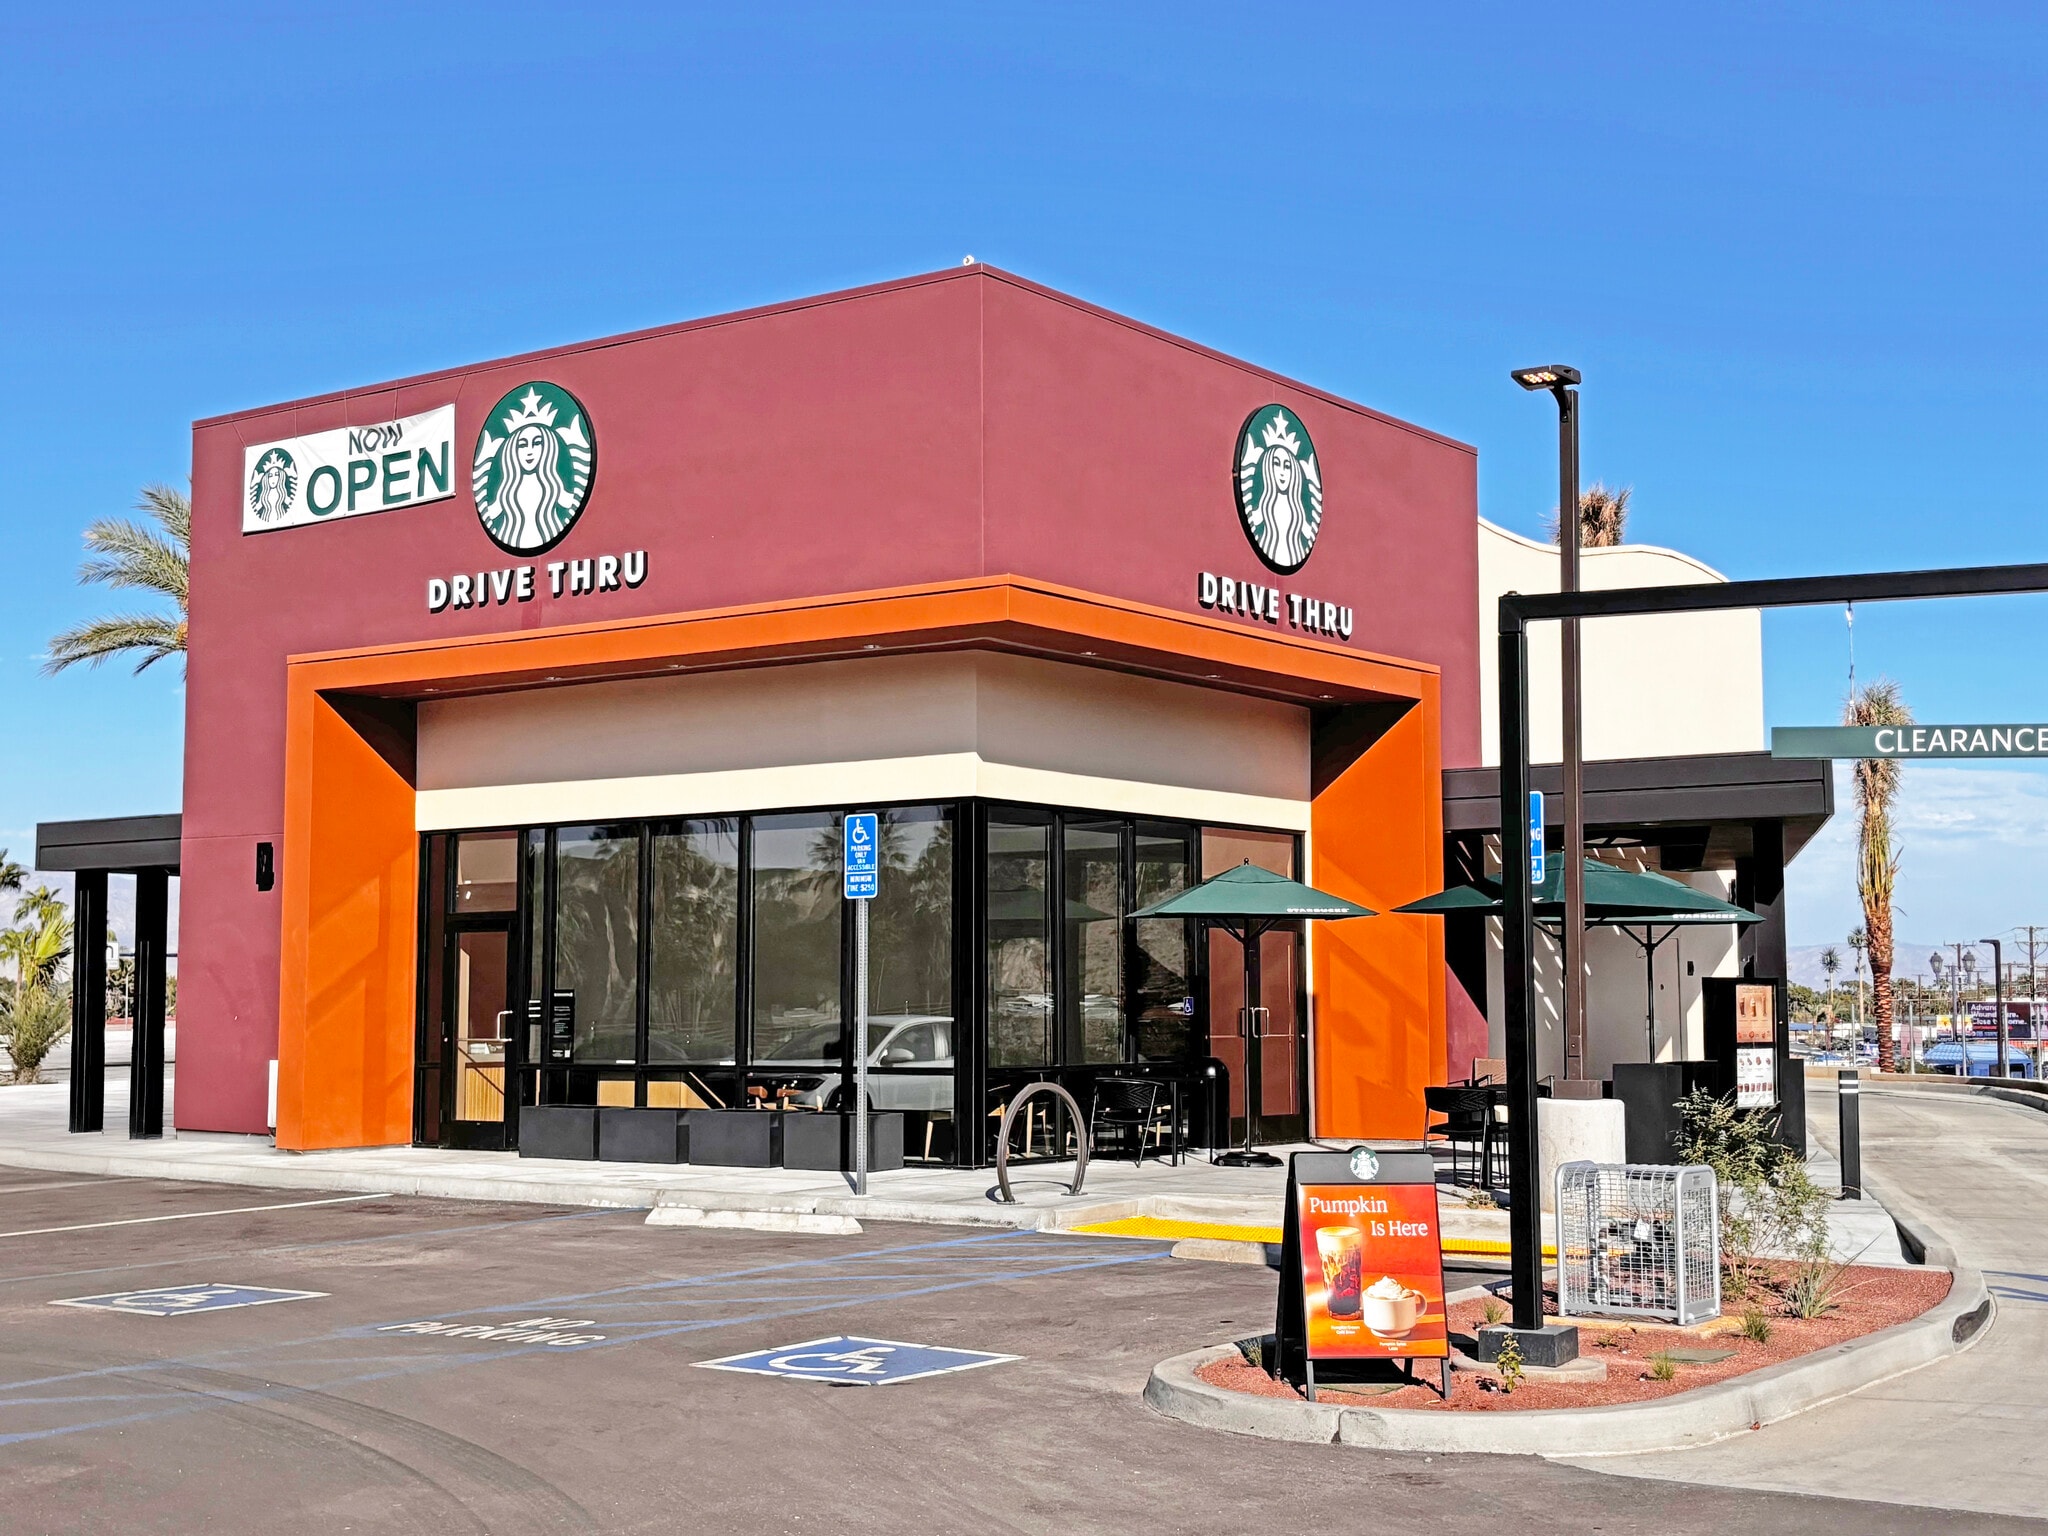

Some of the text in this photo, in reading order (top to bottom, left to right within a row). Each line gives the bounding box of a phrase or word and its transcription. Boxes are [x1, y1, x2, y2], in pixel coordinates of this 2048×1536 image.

[348, 423, 404, 456] NOW
[306, 440, 450, 517] OPEN
[428, 550, 648, 612] DRIVE THRU
[1200, 572, 1353, 638] DRIVE THRU
[1874, 727, 2048, 753] CLEARANCE
[860, 884, 874, 892] $250
[1308, 1195, 1389, 1217] Pumpkin
[1370, 1220, 1429, 1237] Is Here
[377, 1321, 606, 1346] PARKING
[500, 1317, 596, 1329] NO
